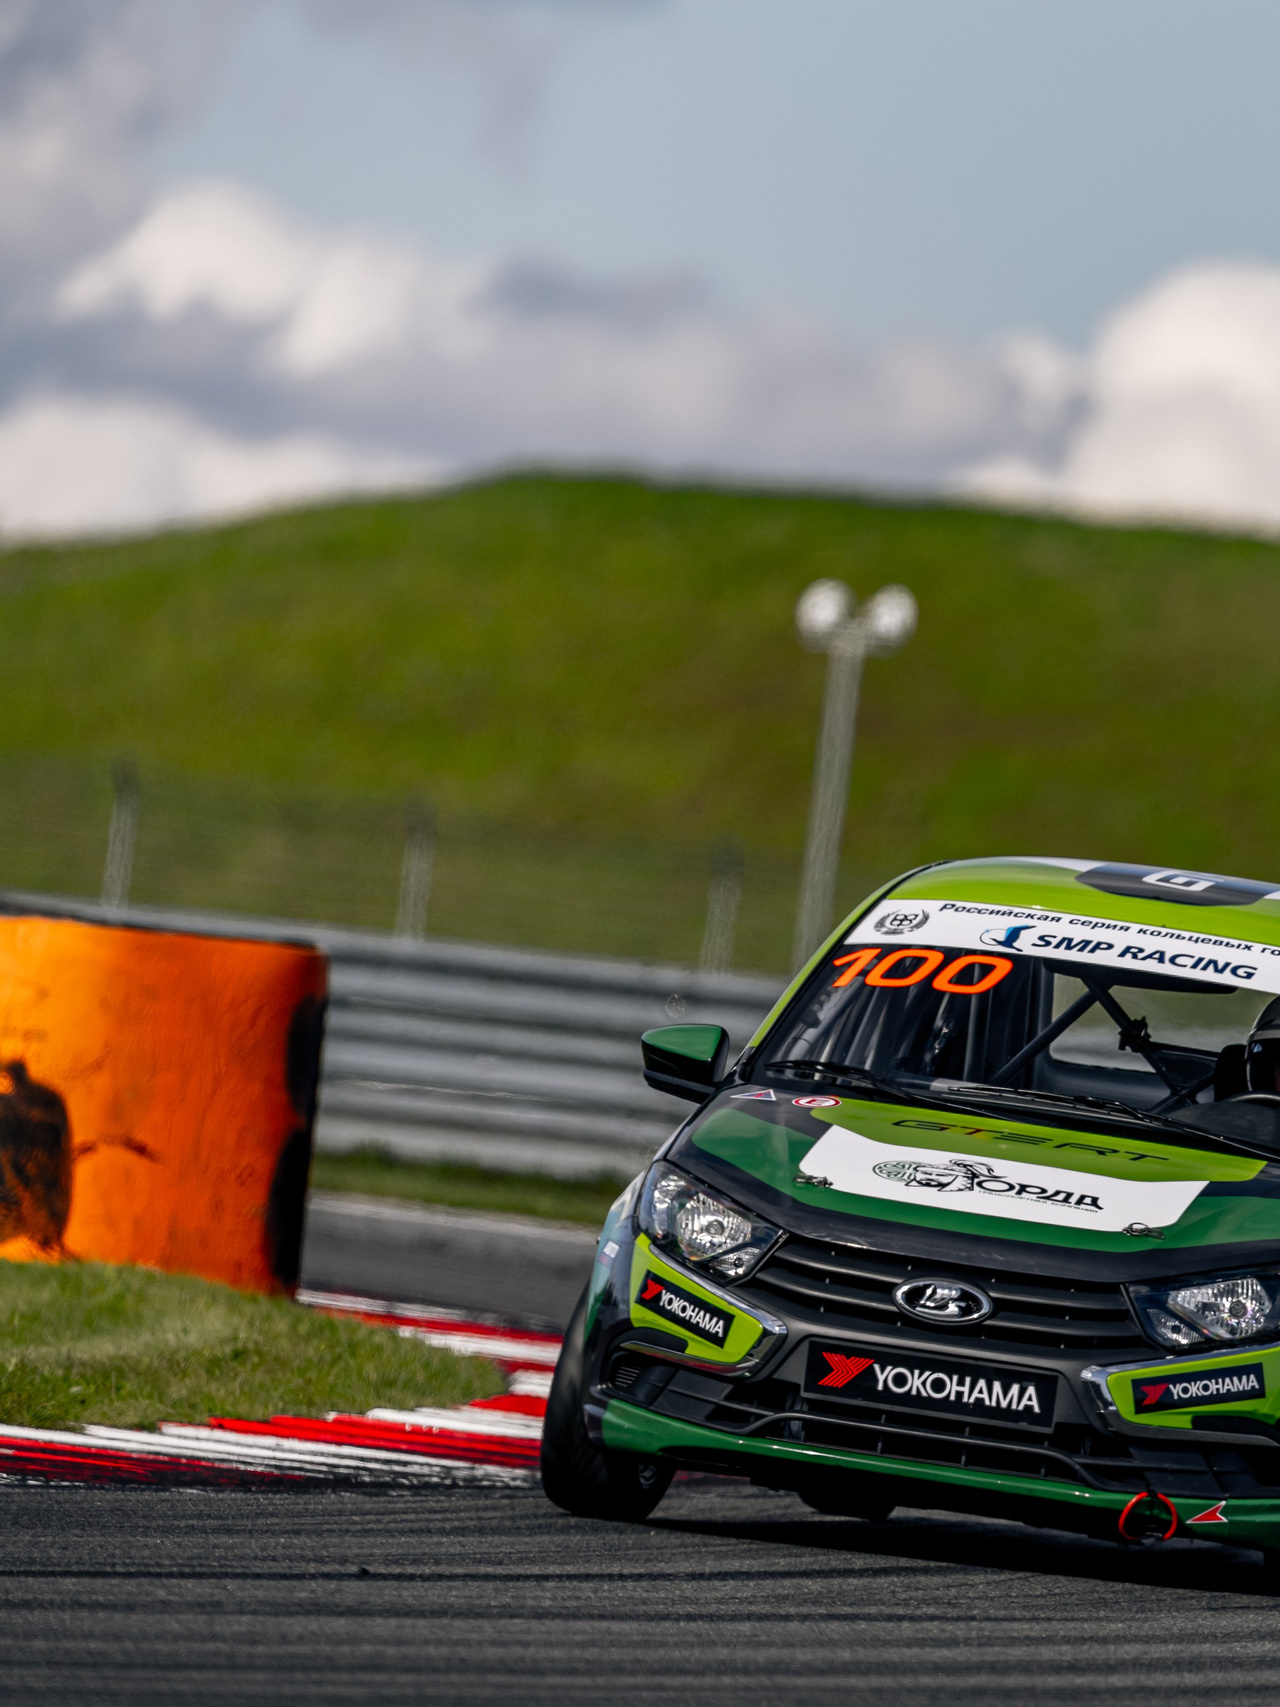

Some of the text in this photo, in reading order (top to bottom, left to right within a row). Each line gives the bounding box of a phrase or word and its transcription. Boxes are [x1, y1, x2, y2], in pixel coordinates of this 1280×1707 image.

[937, 902, 1062, 923] Российская
[1068, 917, 1132, 933] серия
[1136, 927, 1254, 952] кольцевых
[831, 948, 1014, 995] 100
[1031, 934, 1258, 980] SMP RACING
[975, 1179, 1105, 1211] ОРДА
[659, 1289, 725, 1338] YOKOHAMA
[872, 1362, 1042, 1415] YOKOHAMA
[1168, 1373, 1260, 1400] YOKOHAMA
